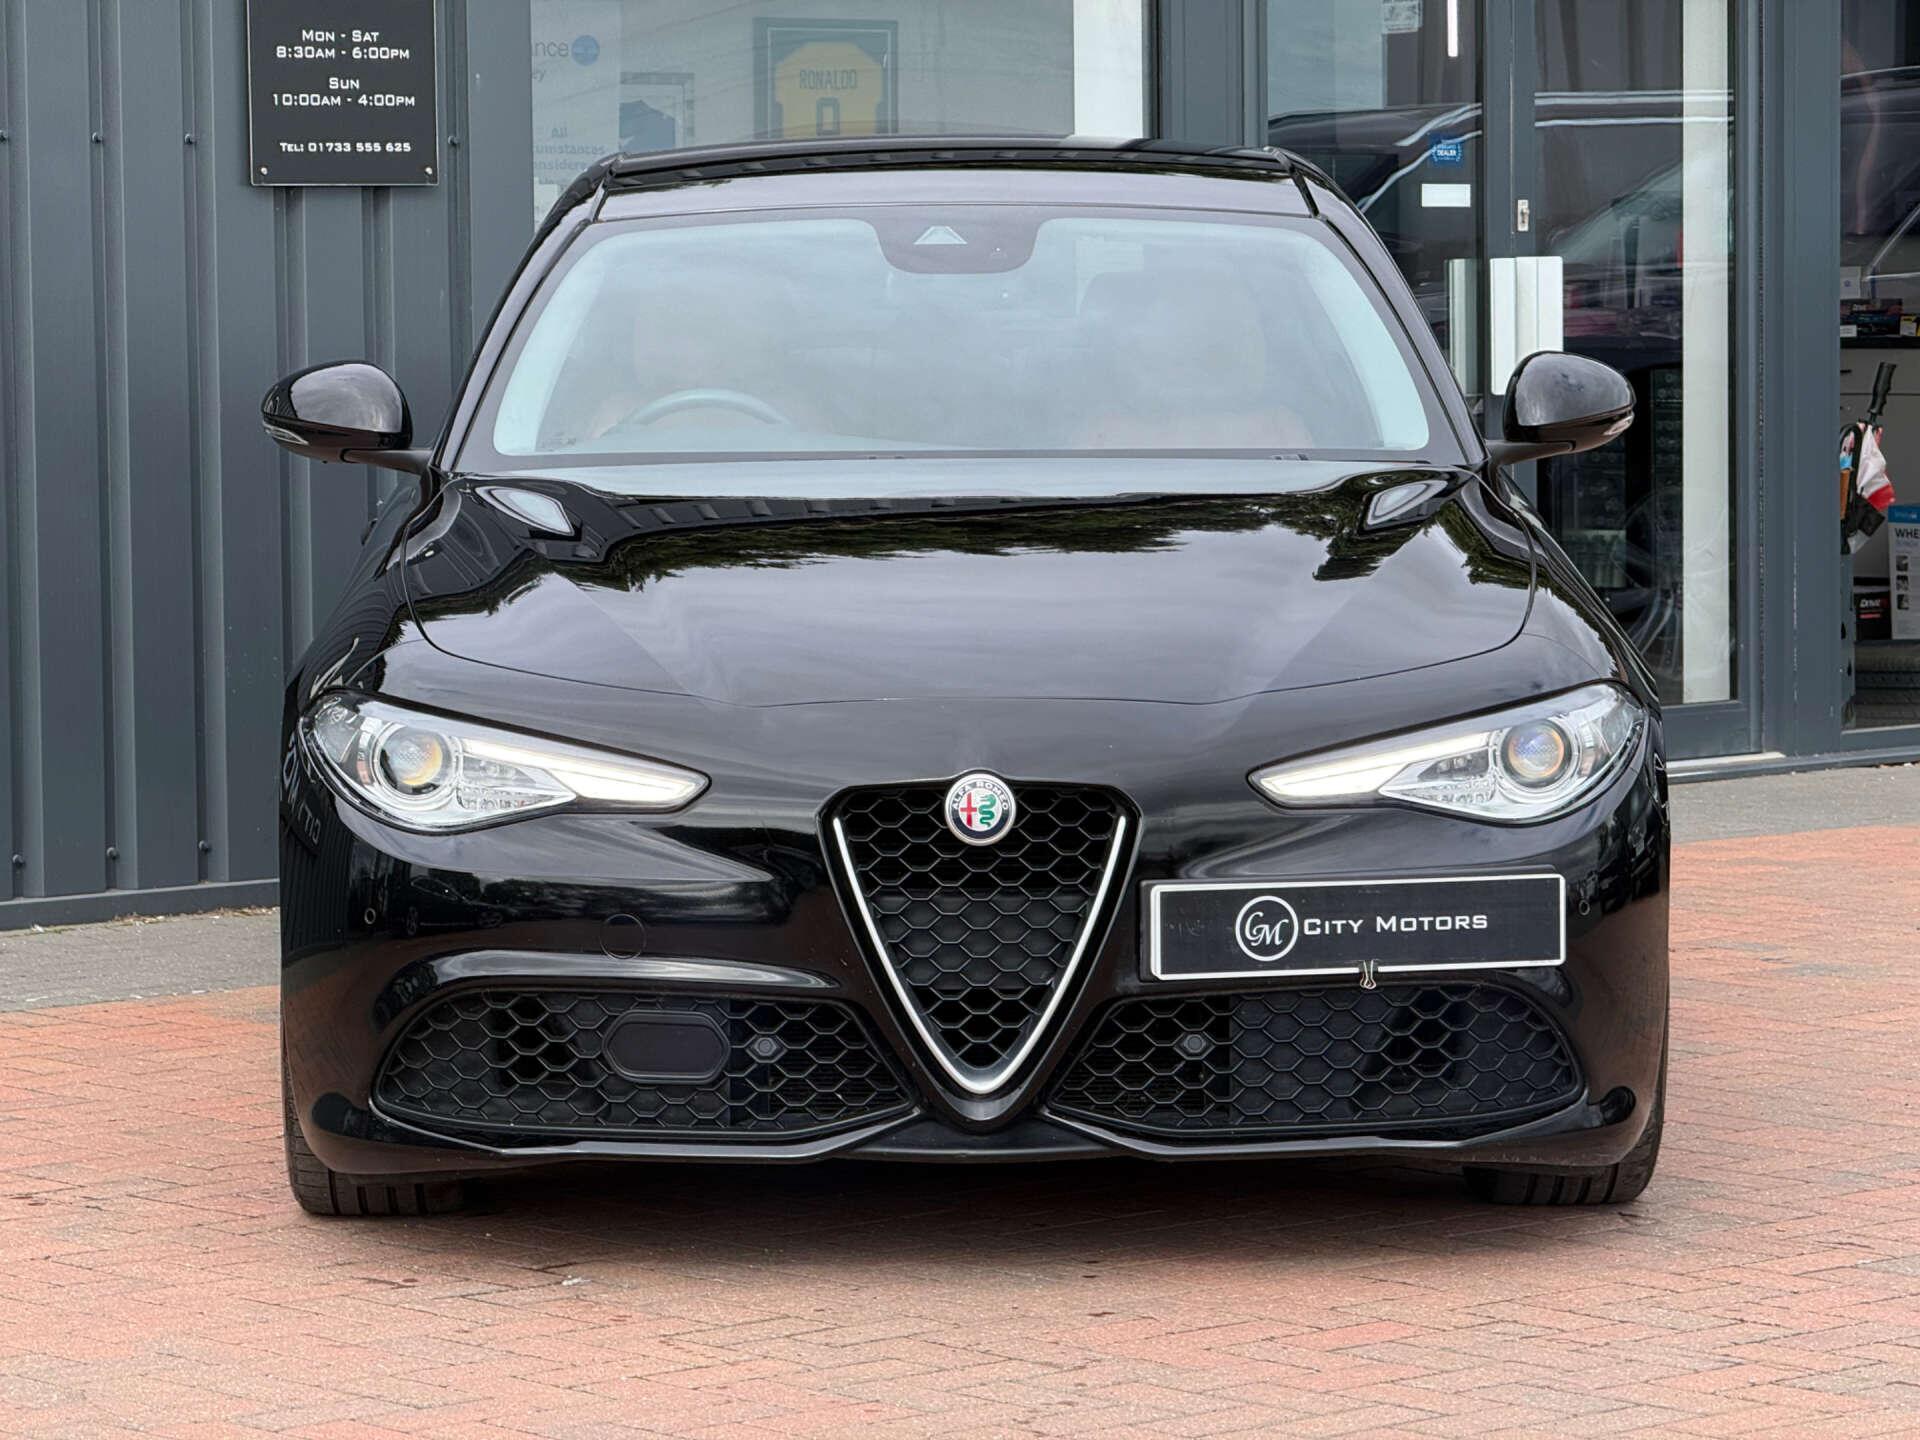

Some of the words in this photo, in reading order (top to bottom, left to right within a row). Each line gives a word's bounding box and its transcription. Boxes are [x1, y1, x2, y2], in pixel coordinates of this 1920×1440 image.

[532, 41, 569, 57] nce
[800, 69, 857, 89] RONALDO
[308, 143, 351, 152] 01733
[356, 143, 381, 152] 555
[386, 142, 411, 152] 625
[952, 784, 973, 810] ALFA
[975, 780, 1009, 810] ROMEO
